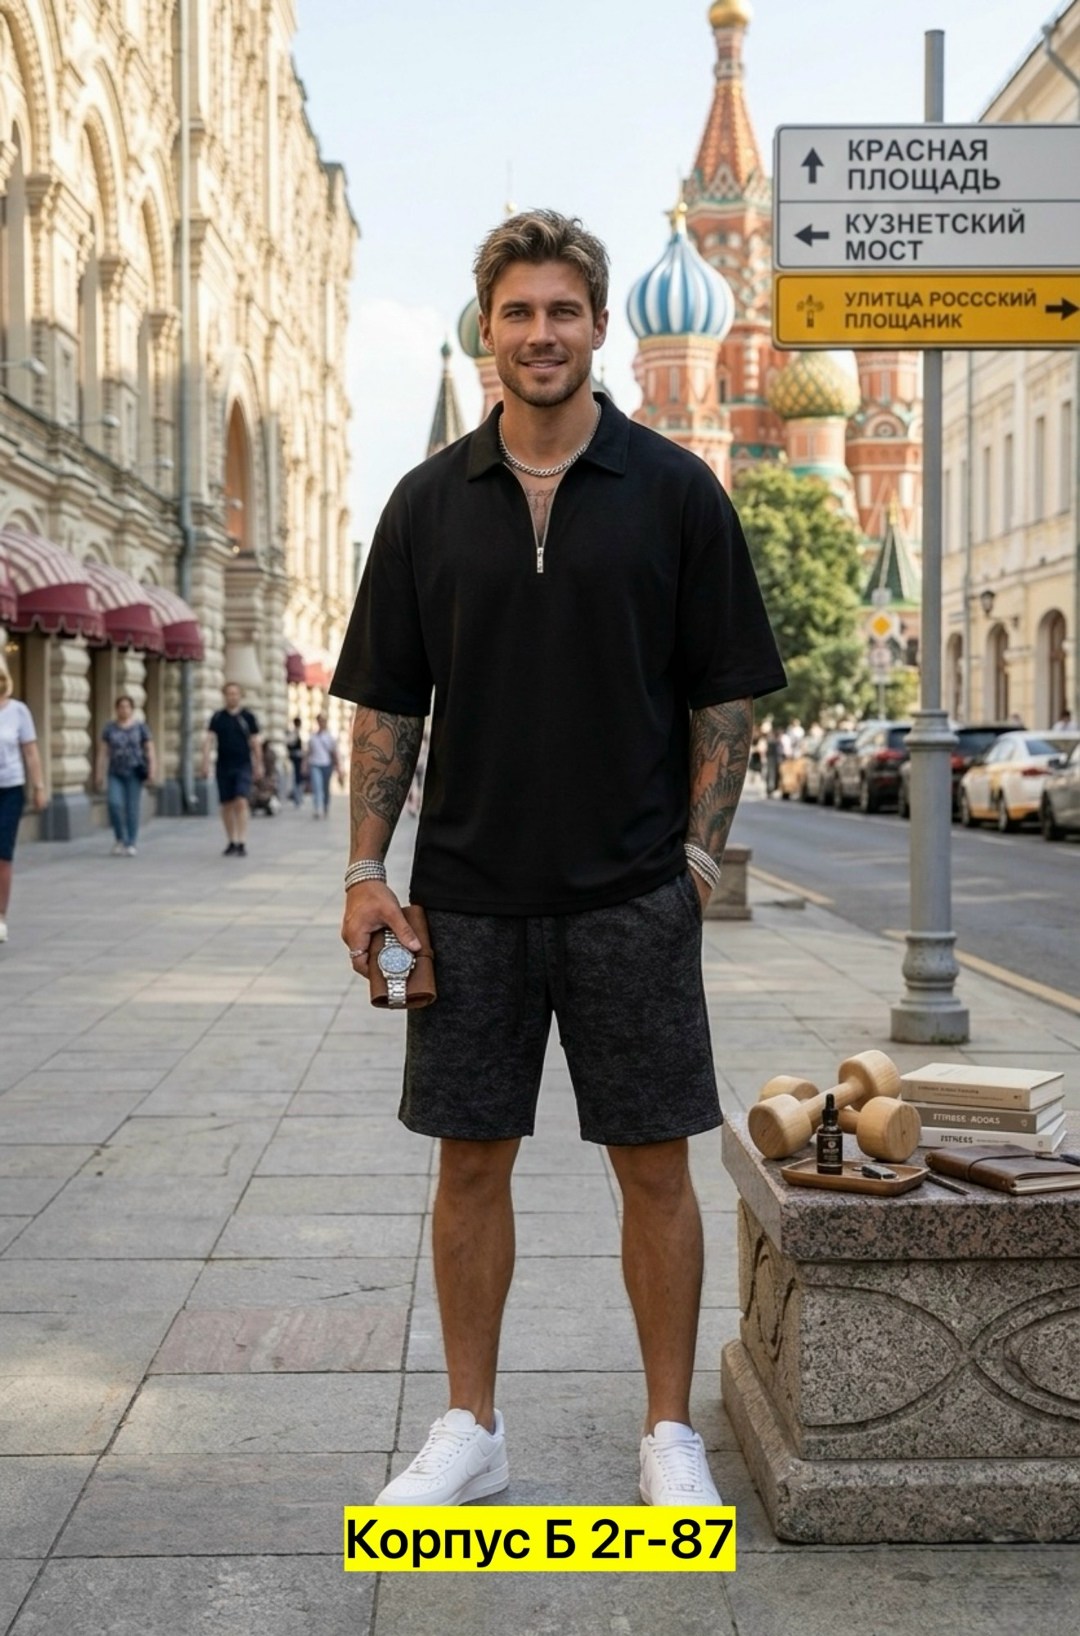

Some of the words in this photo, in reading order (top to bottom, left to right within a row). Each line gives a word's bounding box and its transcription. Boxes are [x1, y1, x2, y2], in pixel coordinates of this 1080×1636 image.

[848, 139, 988, 162] КРАСНАЯ
[848, 168, 1001, 194] ПЛОЩАДЬ
[845, 208, 1025, 235] КУЗНЕТСКИЙ
[845, 240, 923, 261] МОСТ
[845, 291, 923, 309] УЛИТЦА
[929, 288, 1037, 307] РОСССКИЙ
[845, 313, 962, 330] ПЛОЩАНИК
